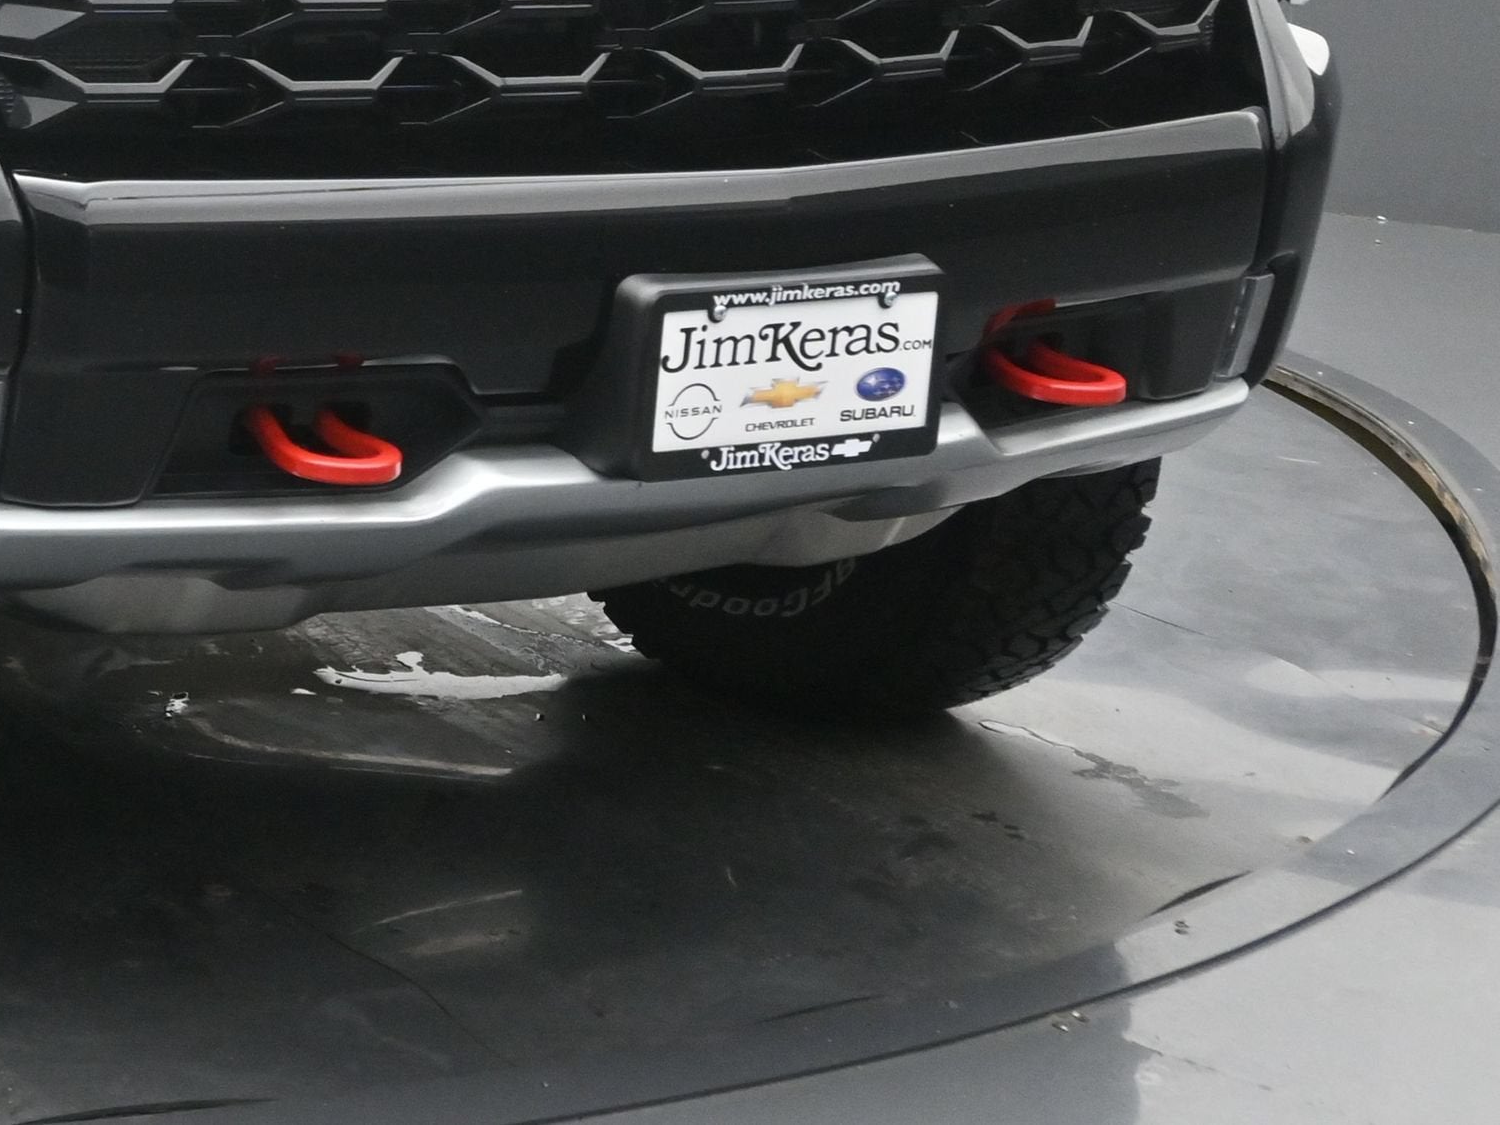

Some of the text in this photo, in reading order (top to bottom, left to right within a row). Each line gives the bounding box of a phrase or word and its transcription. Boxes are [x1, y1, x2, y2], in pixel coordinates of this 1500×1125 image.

[713, 281, 900, 306] www.jimkeras.com
[665, 405, 722, 419] NISSAN
[840, 405, 915, 423] SUBARU
[745, 417, 815, 433] CHEVROLET
